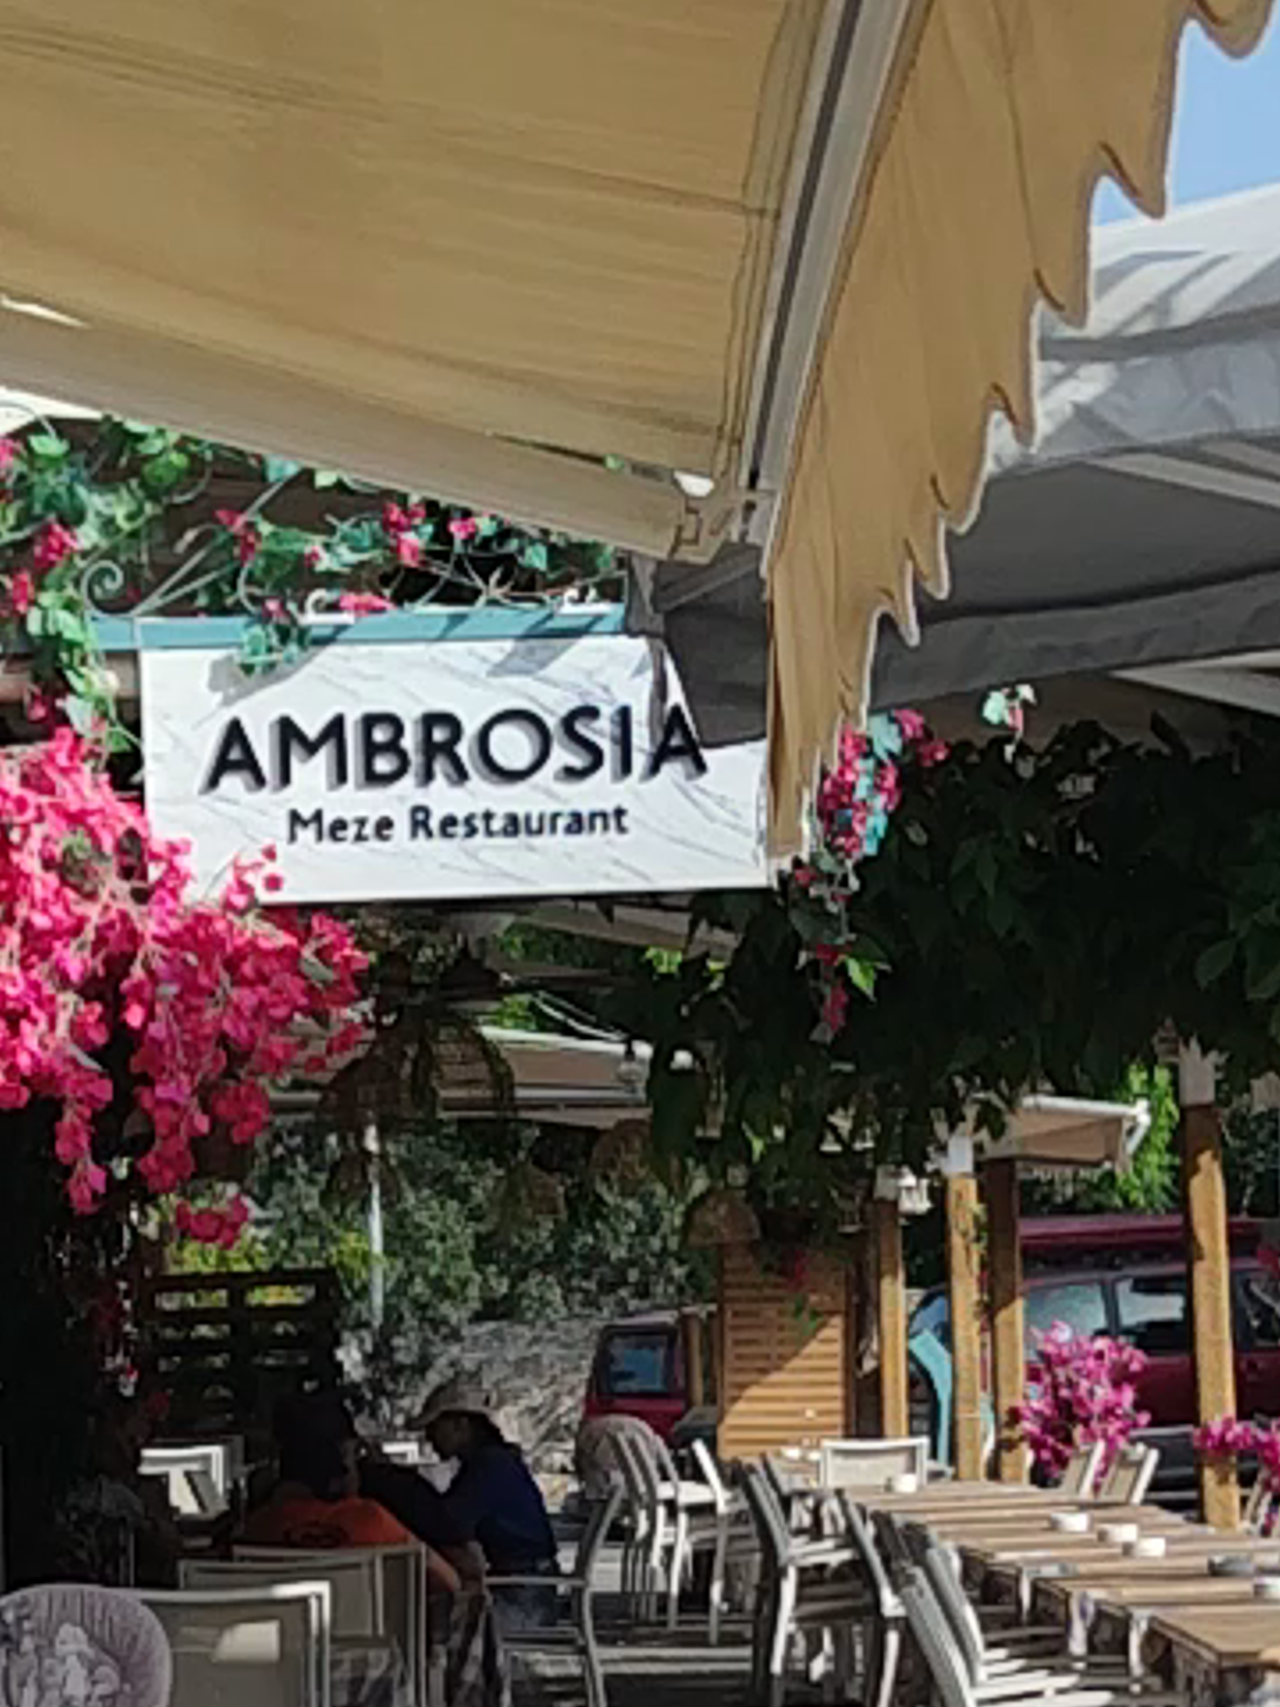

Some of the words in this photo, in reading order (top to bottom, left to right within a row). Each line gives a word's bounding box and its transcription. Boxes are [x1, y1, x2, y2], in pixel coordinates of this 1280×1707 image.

[201, 704, 708, 793] AMBROSIA
[287, 807, 395, 845] Meze
[409, 804, 629, 841] Restaurant
